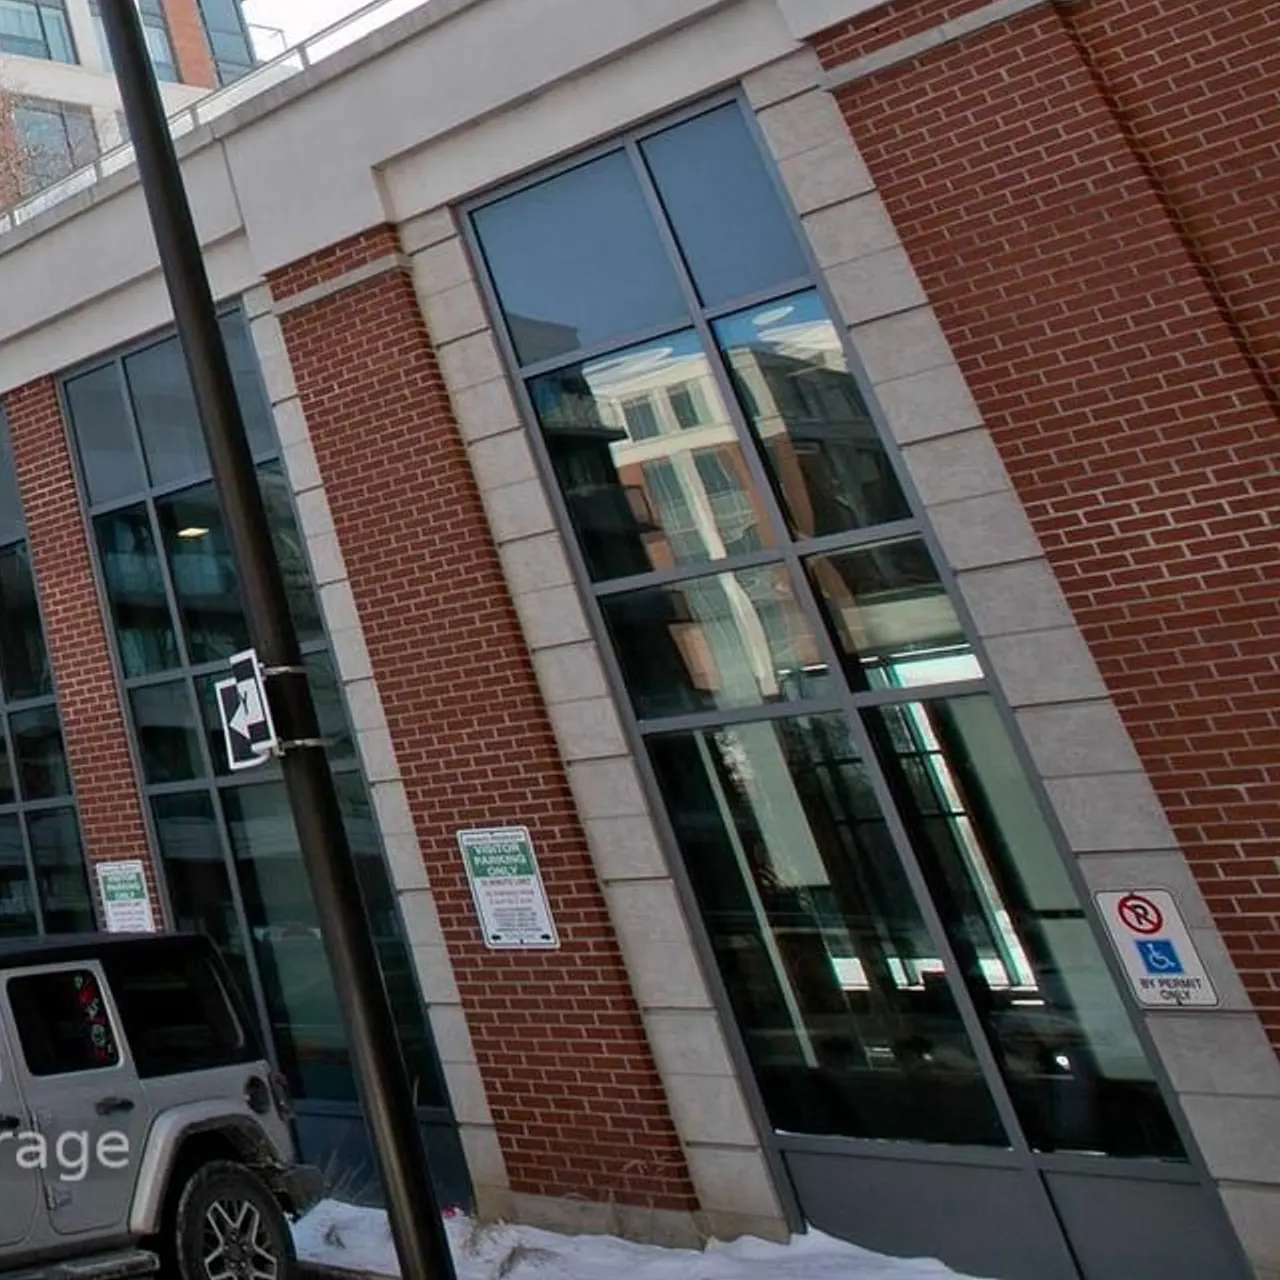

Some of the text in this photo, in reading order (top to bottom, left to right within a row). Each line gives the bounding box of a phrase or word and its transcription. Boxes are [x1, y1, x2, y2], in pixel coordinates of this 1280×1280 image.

[473, 843, 521, 854] VISITOR
[474, 854, 527, 865] PARKING
[487, 866, 518, 877] ONLY
[1139, 977, 1202, 989] BY PERMIT
[1160, 989, 1191, 1000] ONLY
